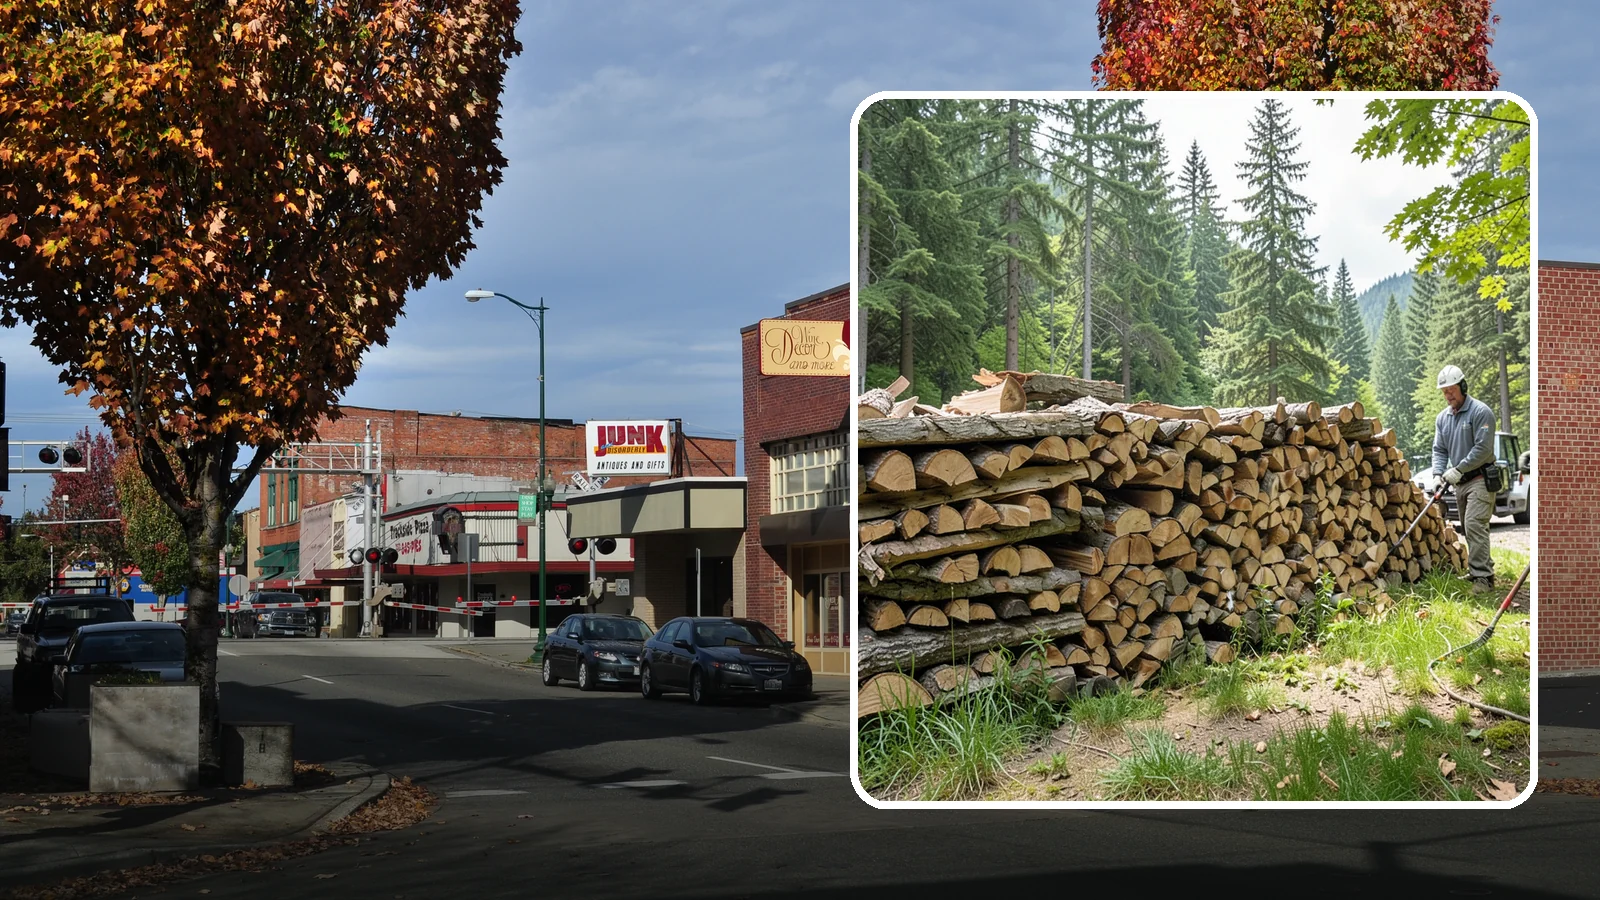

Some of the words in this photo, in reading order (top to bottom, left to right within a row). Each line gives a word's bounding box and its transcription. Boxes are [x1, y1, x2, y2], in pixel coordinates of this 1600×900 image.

[595, 425, 665, 457] JUNK
[607, 446, 646, 454] DISORDERLY
[597, 461, 628, 470] ANTIQUES
[631, 461, 644, 470] AND
[647, 461, 665, 470] GIFTS
[391, 523, 412, 540] Trackside
[414, 520, 429, 535] Pizza
